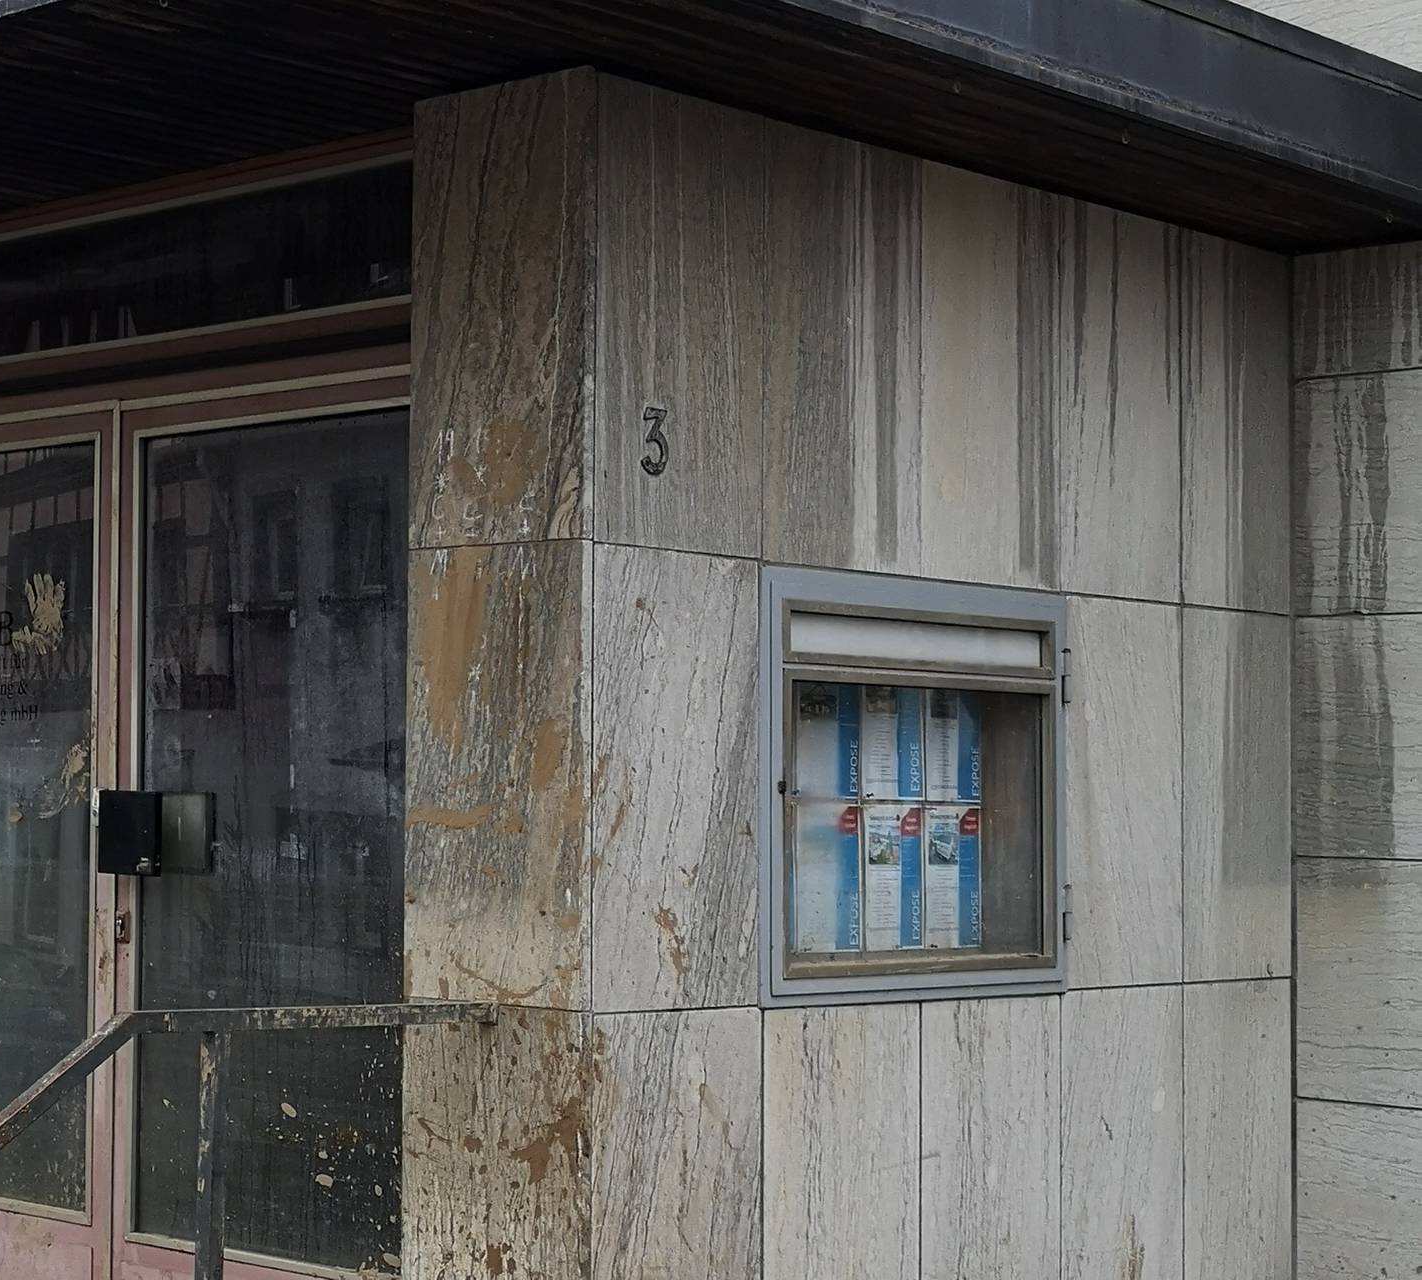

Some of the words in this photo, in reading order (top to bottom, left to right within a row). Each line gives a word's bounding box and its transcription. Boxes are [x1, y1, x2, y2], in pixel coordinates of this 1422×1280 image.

[641, 407, 669, 475] 3
[18, 679, 28, 695] &
[11, 703, 38, 721] mbH
